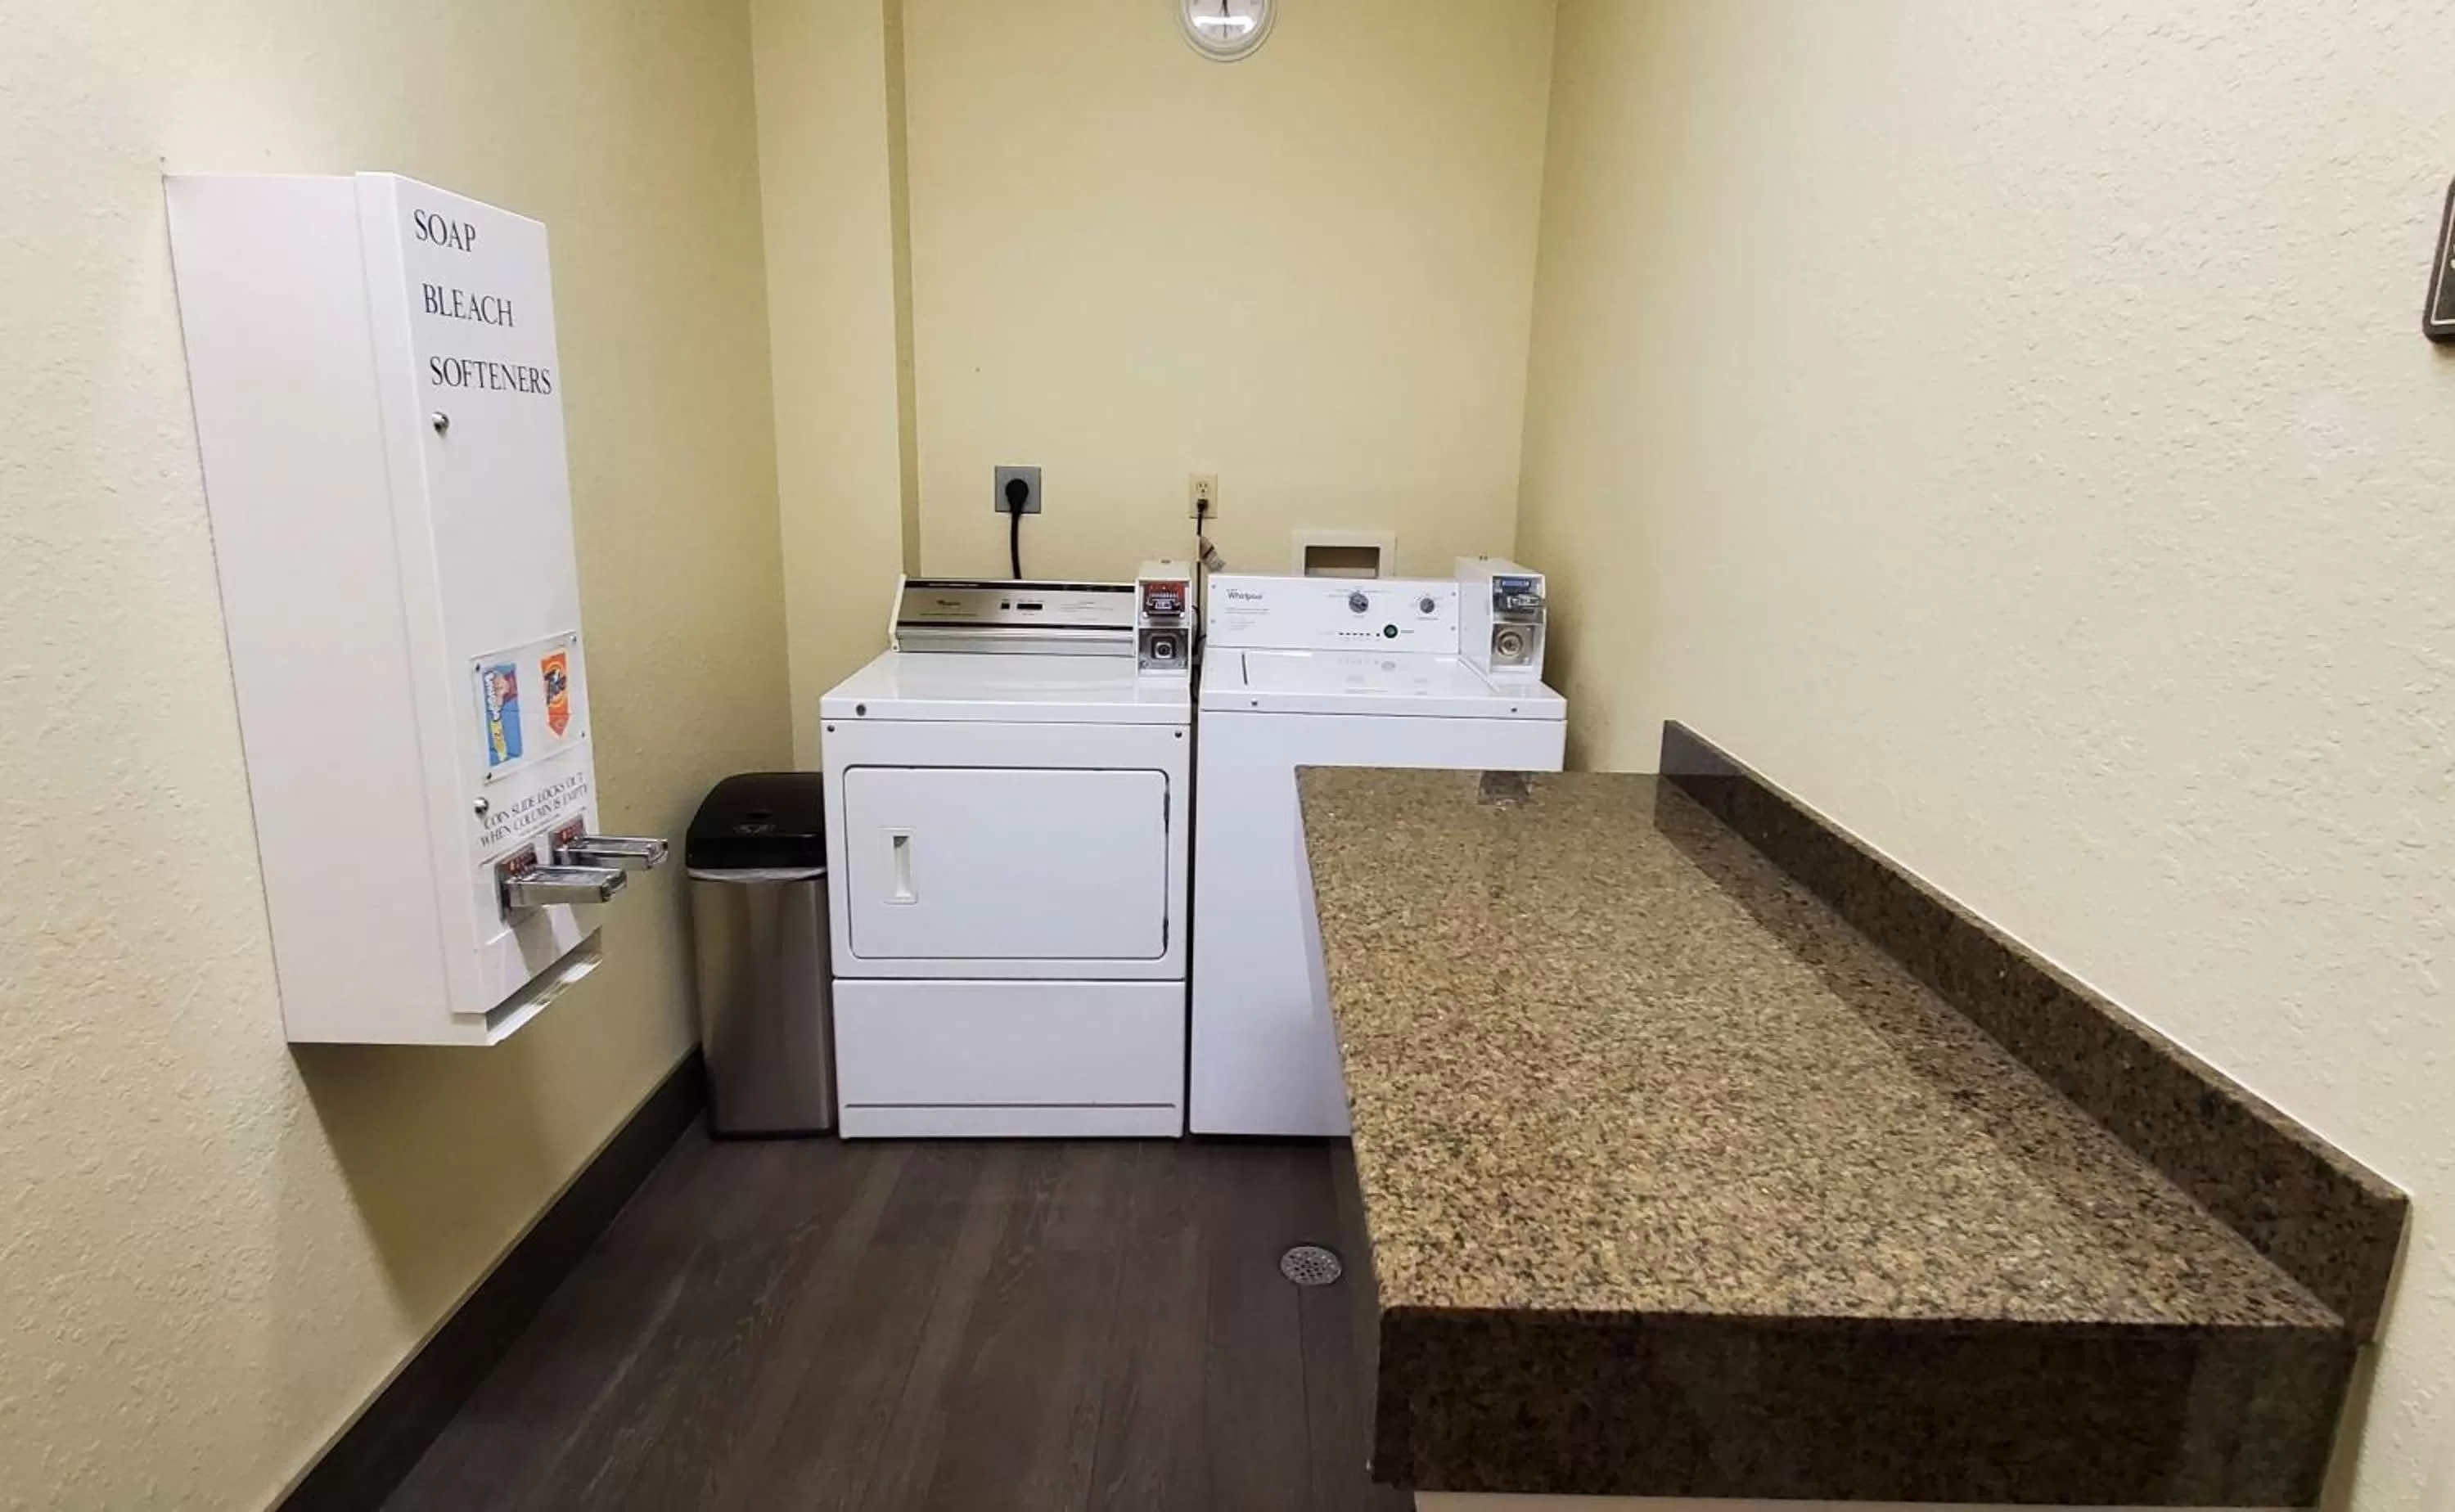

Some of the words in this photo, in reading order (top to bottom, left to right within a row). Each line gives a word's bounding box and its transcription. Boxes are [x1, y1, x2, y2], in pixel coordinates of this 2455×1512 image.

[413, 209, 476, 252] SOAP
[421, 283, 515, 327] BLEACH
[430, 356, 552, 395] SOFTENERS
[1228, 591, 1264, 601] Whirlpool
[480, 826, 511, 847] WHEN
